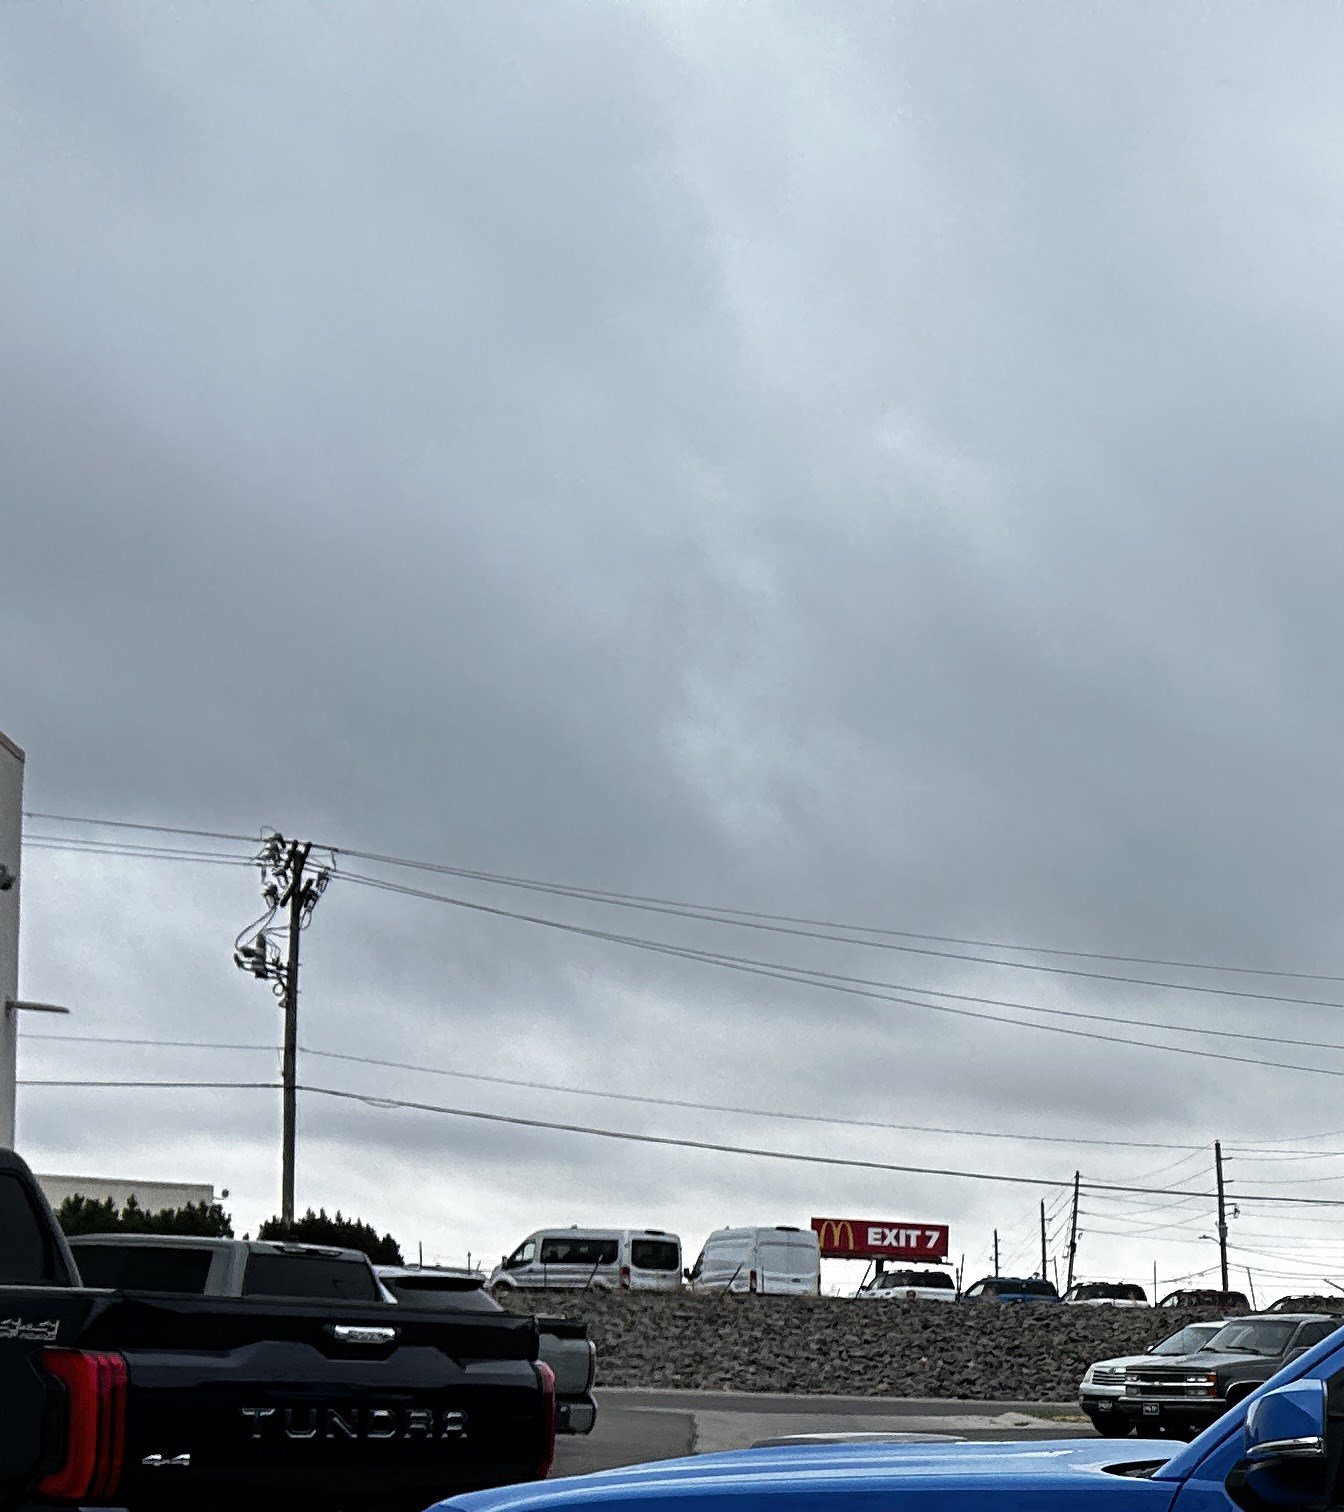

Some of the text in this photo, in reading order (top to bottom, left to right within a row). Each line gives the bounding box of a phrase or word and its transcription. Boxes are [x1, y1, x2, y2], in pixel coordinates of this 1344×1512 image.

[867, 1227, 922, 1249] EXIT
[925, 1229, 940, 1249] 7
[241, 1408, 469, 1438] TUNDRA
